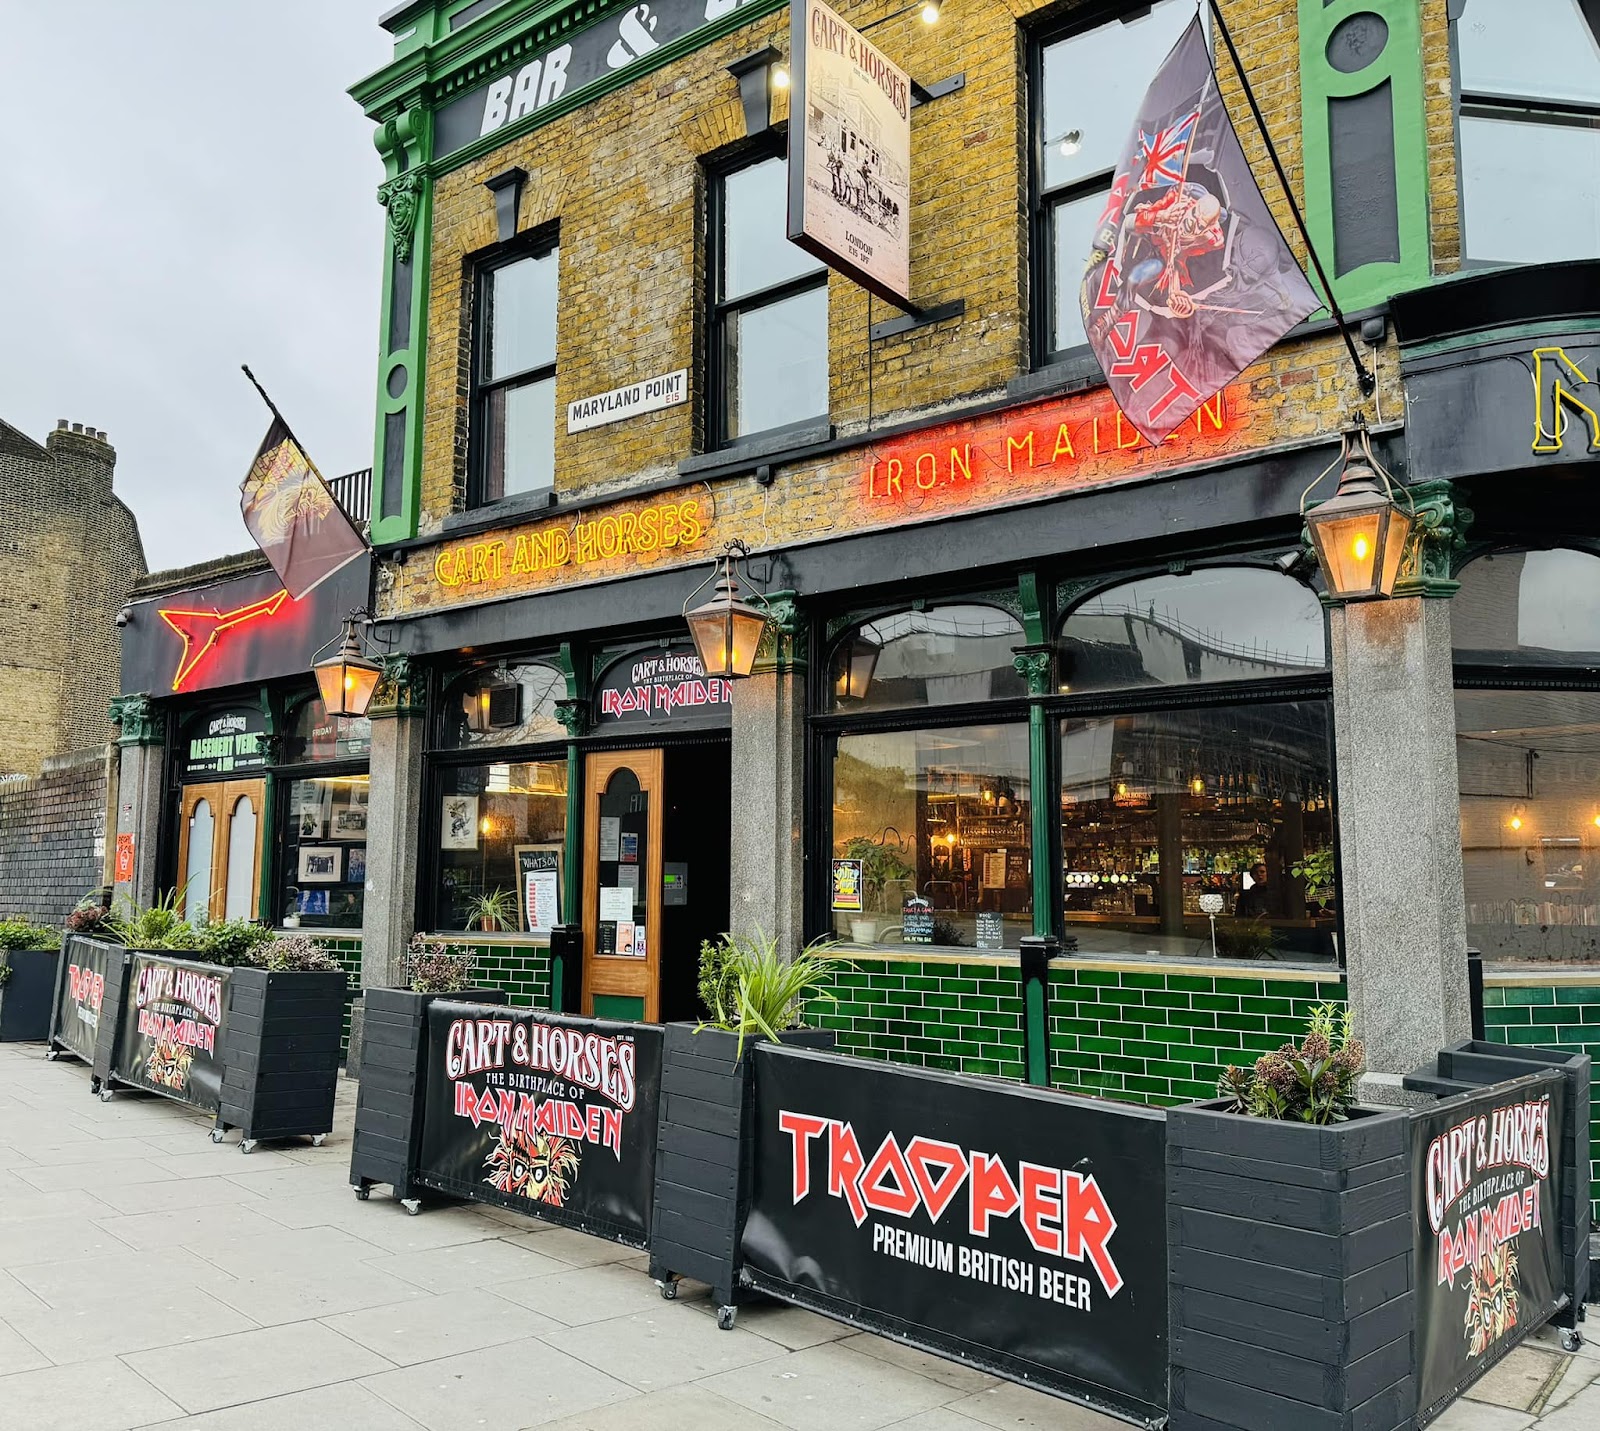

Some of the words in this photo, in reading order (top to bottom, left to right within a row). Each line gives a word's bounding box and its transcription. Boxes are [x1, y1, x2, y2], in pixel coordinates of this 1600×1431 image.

[480, 43, 572, 137] BAR
[606, 3, 660, 68] &
[811, 7, 848, 57] CART
[850, 35, 858, 65] &
[860, 43, 907, 122] HORSES
[845, 230, 873, 256] LONDON
[848, 245, 858, 258] E15
[573, 387, 640, 420] MARYLAND
[645, 374, 682, 400] POINT
[665, 391, 680, 404] E15
[868, 443, 973, 499] IRON
[1006, 390, 1223, 473] MAIDN
[434, 541, 505, 587] CART
[511, 527, 570, 574] AND
[576, 500, 701, 564] HORSES
[632, 660, 658, 683] CART
[658, 659, 666, 672] &
[666, 656, 704, 677] HORSES
[602, 685, 652, 719] IRON
[69, 964, 104, 1018] TROOER
[137, 967, 167, 1009] CART
[167, 972, 174, 996] &
[174, 967, 221, 1027] HORSES
[138, 1009, 164, 1047] IRON
[162, 1016, 215, 1059] MAIDEN
[446, 1019, 512, 1080] CART
[512, 1022, 529, 1065] &
[531, 1022, 636, 1113] HORSES
[486, 1073, 505, 1086] THE
[508, 1074, 566, 1099] BIRTHPLACE
[569, 1086, 585, 1100] OF
[455, 1081, 517, 1139] IRON
[516, 1092, 623, 1162] MAIDEN
[1426, 1116, 1477, 1236] CART
[1476, 1114, 1488, 1172] &
[1487, 1099, 1549, 1179] HORSES
[1459, 1192, 1471, 1215] THE
[1473, 1172, 1514, 1206] BIRTHPLACE
[1515, 1170, 1525, 1186] OF
[778, 1109, 1124, 1299] TROOPER
[1480, 1179, 1543, 1268] MAIDEN
[873, 1222, 954, 1274] PREMIUM
[958, 1244, 1033, 1296] BRITISH
[1039, 1266, 1092, 1312] BEER
